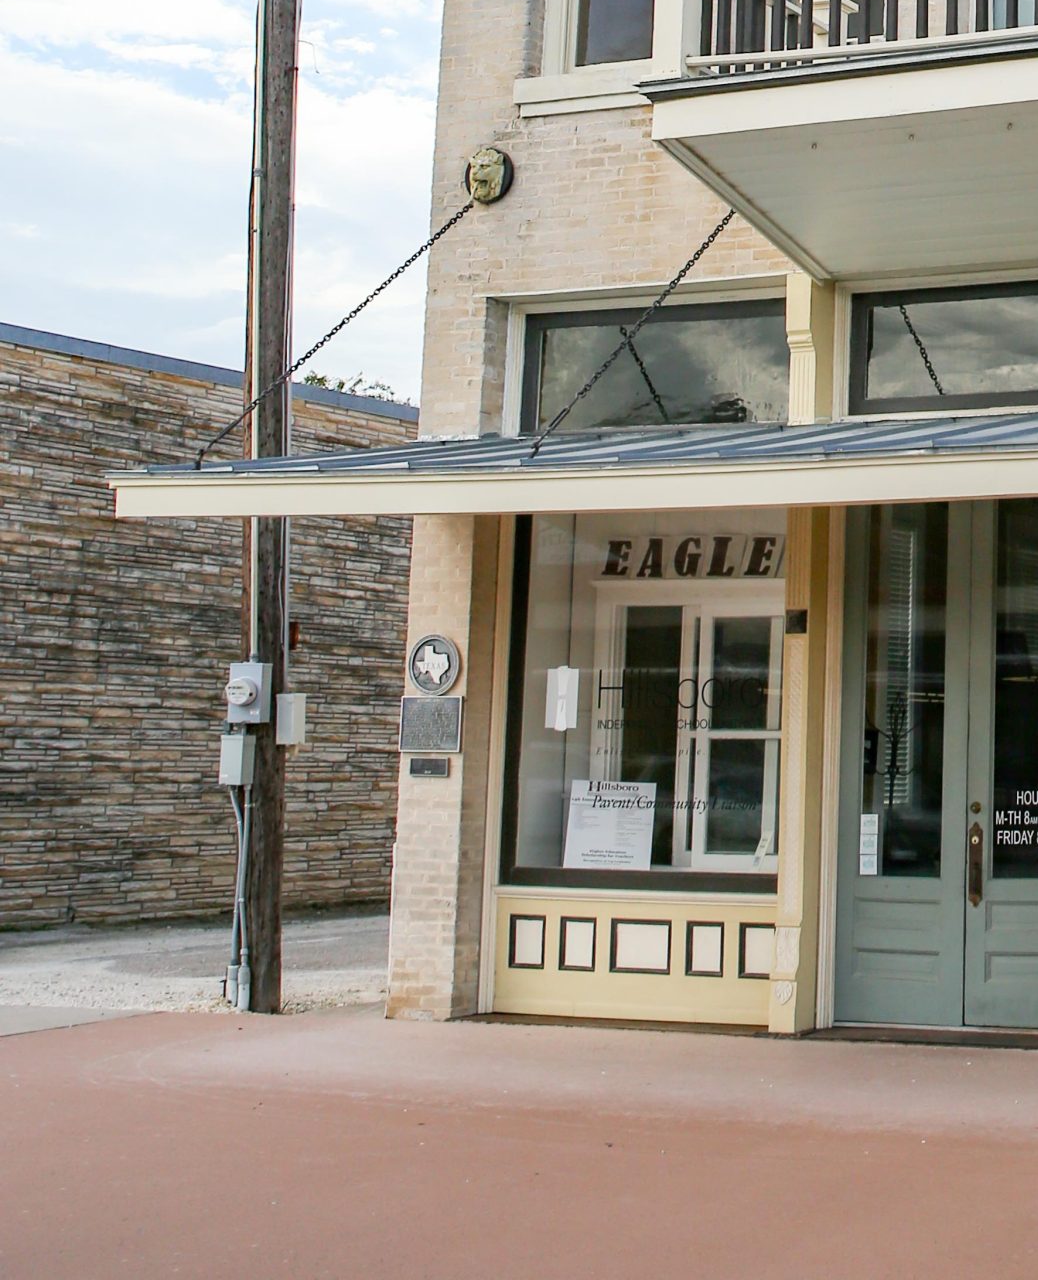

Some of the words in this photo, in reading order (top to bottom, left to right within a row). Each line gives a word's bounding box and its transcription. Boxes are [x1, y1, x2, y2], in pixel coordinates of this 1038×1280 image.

[601, 536, 777, 578] EAGLE
[588, 781, 640, 792] Hillsboro
[995, 810, 1022, 825] M-TH
[996, 830, 1035, 845] FRIDAY
